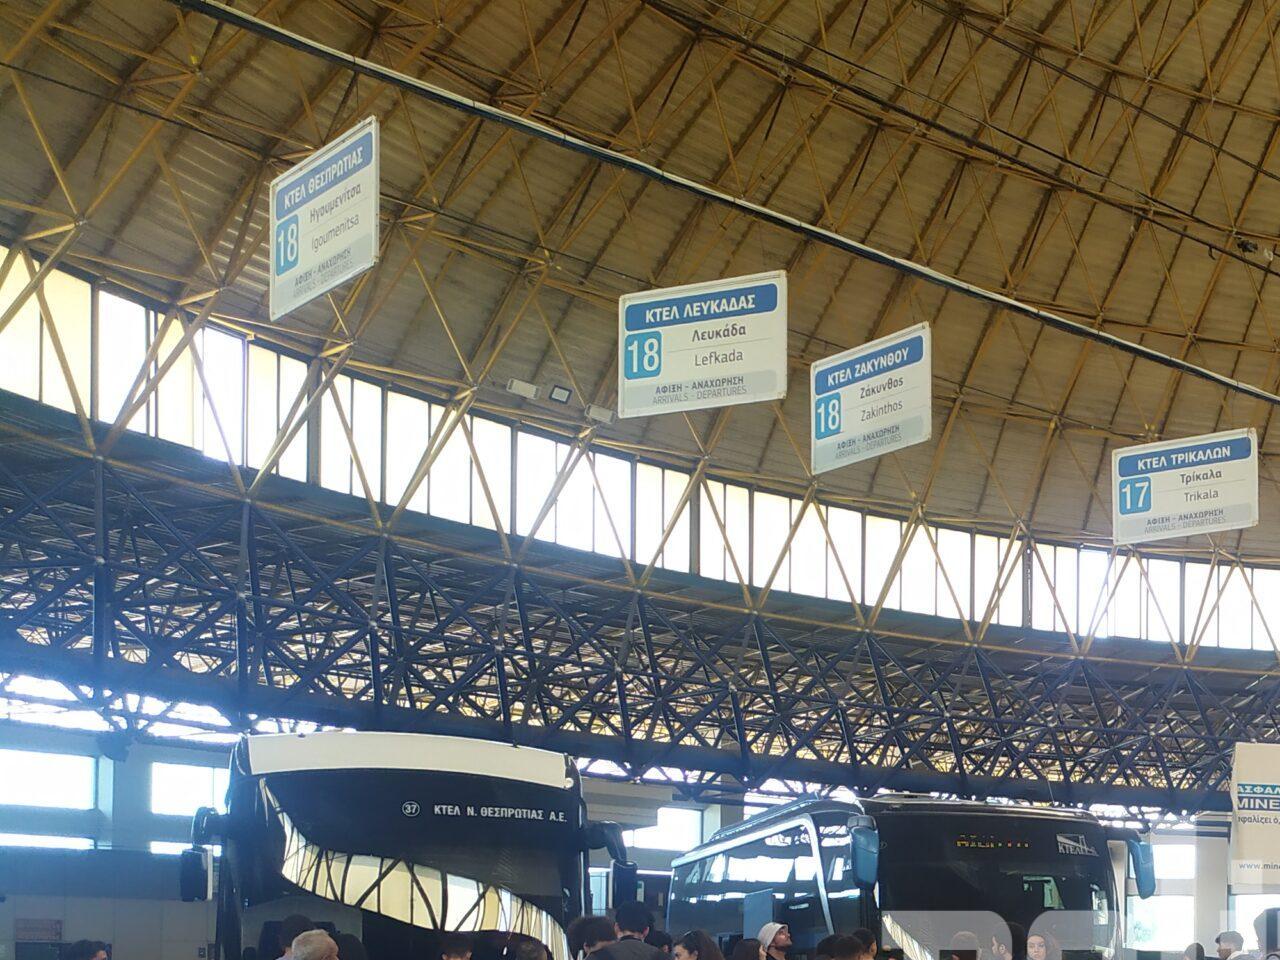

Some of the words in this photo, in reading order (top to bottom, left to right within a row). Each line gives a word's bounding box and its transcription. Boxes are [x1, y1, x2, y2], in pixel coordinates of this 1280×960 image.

[284, 187, 307, 210] ΚΤΕΛ
[309, 147, 363, 194] ΘΕΣΠΡΩΤΙΑΣ
[310, 183, 361, 223] Ηγουμενίτσα
[311, 213, 360, 252] Igoumenitsa
[278, 223, 298, 266] 18
[645, 306, 679, 323] ΚΤΕΛ
[683, 294, 756, 318] ΛΕΥΚΑΔΑΣ
[692, 323, 746, 342] Λευκάδα
[628, 338, 660, 373] 18
[695, 349, 743, 366] Lefkada
[827, 371, 852, 387] ΚΤΕΛ
[855, 347, 909, 378] ΖΑΚΥΝΘΟΥ
[656, 383, 682, 395] ΑΦΙΞΗ
[692, 376, 744, 390] ΑΝΑΧΩΡΗΣΗ
[697, 386, 747, 400] DEPARTURES
[860, 376, 904, 399] Ζάκυνθος
[817, 398, 840, 433] 18
[861, 400, 903, 422] Zakinthos
[1138, 457, 1167, 471] ΚΤΕΛ
[1171, 446, 1231, 466] ΤΡΙΚΑΛΩΝ
[1180, 469, 1222, 485] Τρίκαλα
[1122, 482, 1148, 510] 17
[1184, 489, 1219, 502] Trikala
[1147, 516, 1170, 526] ΑΦΙΞΗ
[1178, 509, 1224, 521] ΑΝΑΧΩΡΗΣΗ
[405, 805, 417, 814] 37
[434, 804, 461, 816] ΚΤΕΛ
[480, 806, 544, 820] ΘΕΣΠΡΩΤΙΑΣ
